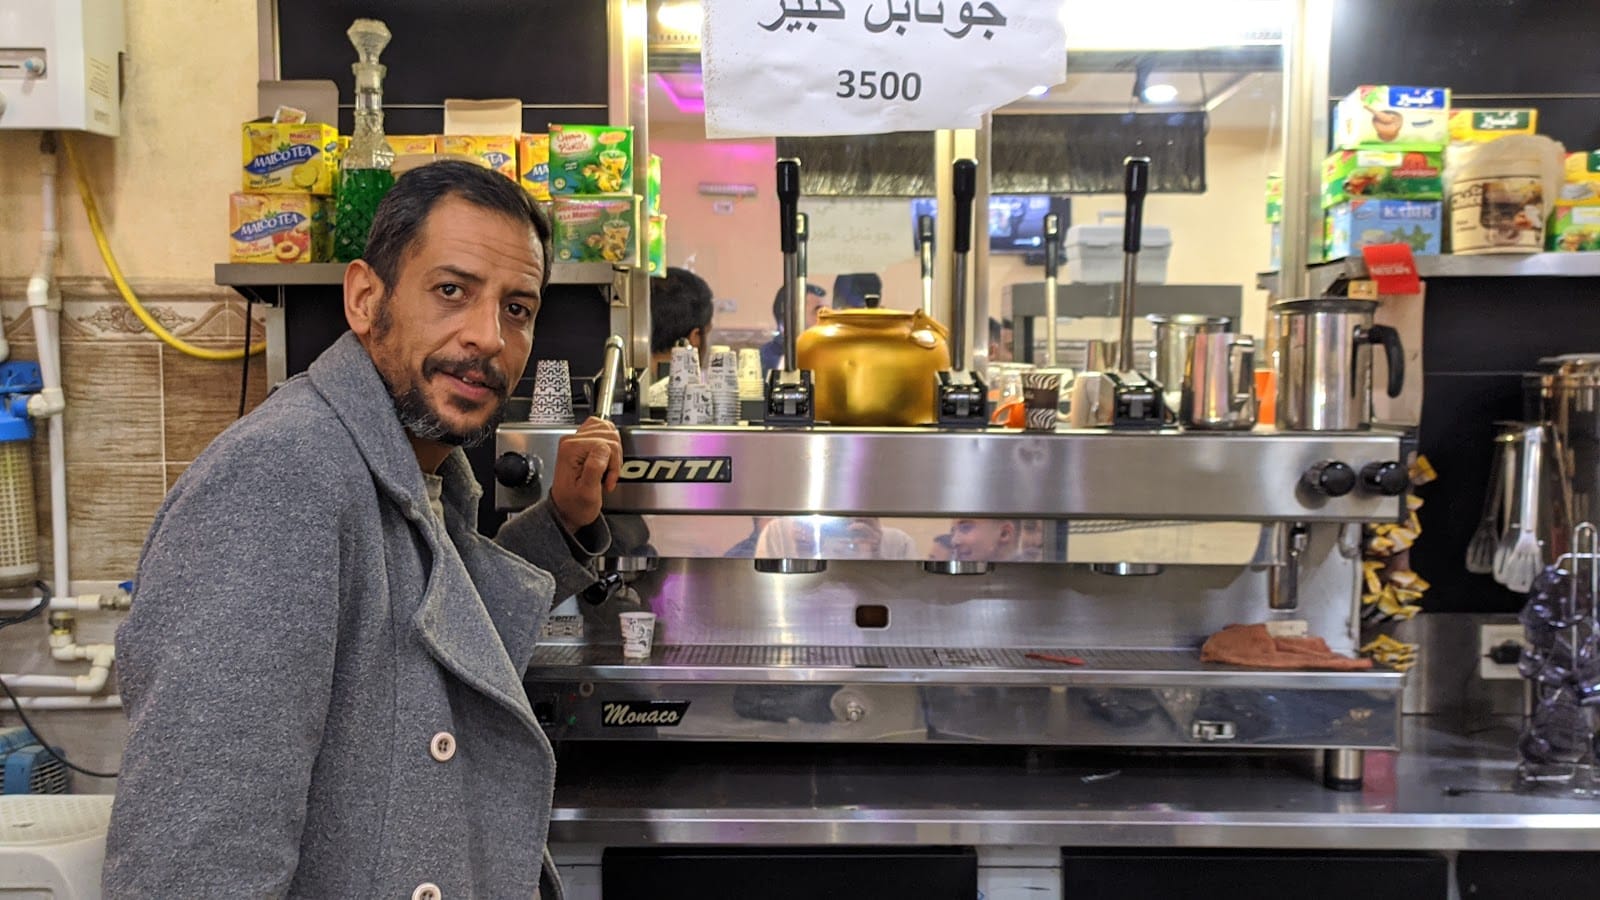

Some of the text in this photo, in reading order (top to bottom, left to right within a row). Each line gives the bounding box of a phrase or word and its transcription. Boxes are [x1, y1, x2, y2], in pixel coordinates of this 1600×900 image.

[836, 69, 922, 101] 3500
[290, 146, 312, 160] TEA
[278, 213, 299, 226] TEA
[619, 459, 724, 480] ONTI
[603, 703, 680, 725] Monaco
